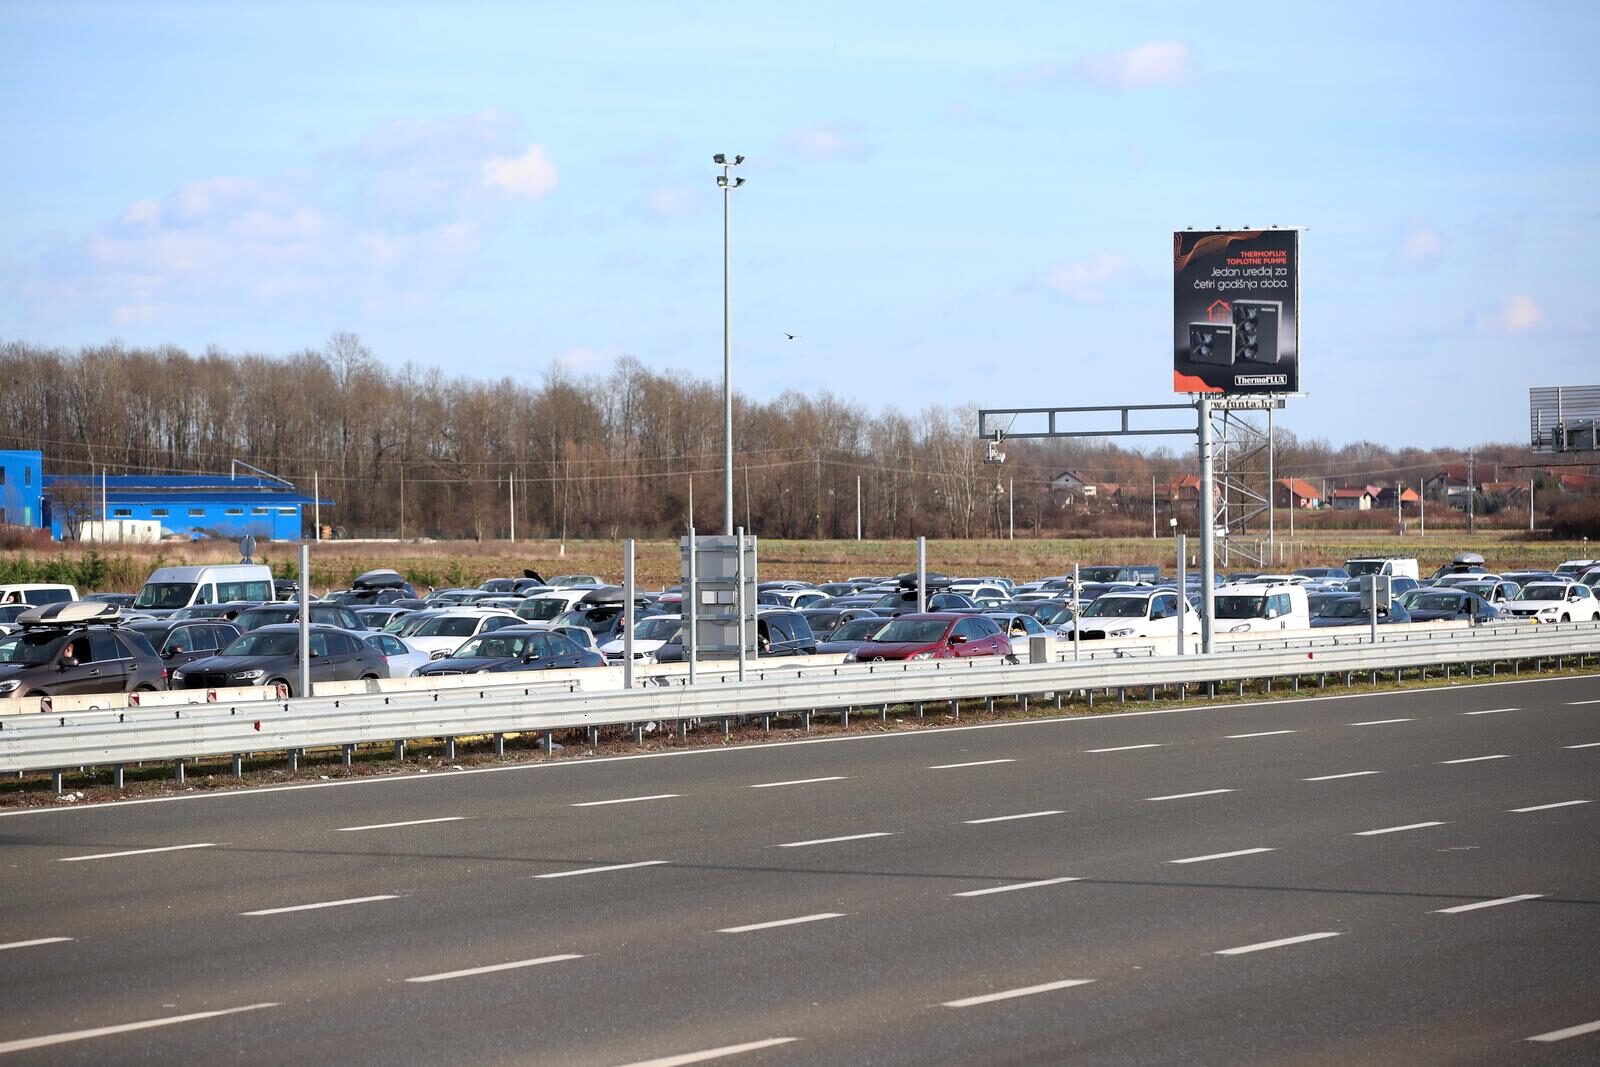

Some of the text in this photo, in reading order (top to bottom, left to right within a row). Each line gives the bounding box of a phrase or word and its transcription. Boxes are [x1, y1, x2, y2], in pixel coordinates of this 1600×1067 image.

[1211, 267, 1240, 276] Jedan
[1275, 268, 1287, 276] za
[1193, 279, 1215, 289] četiri
[1217, 279, 1257, 291] godišnja
